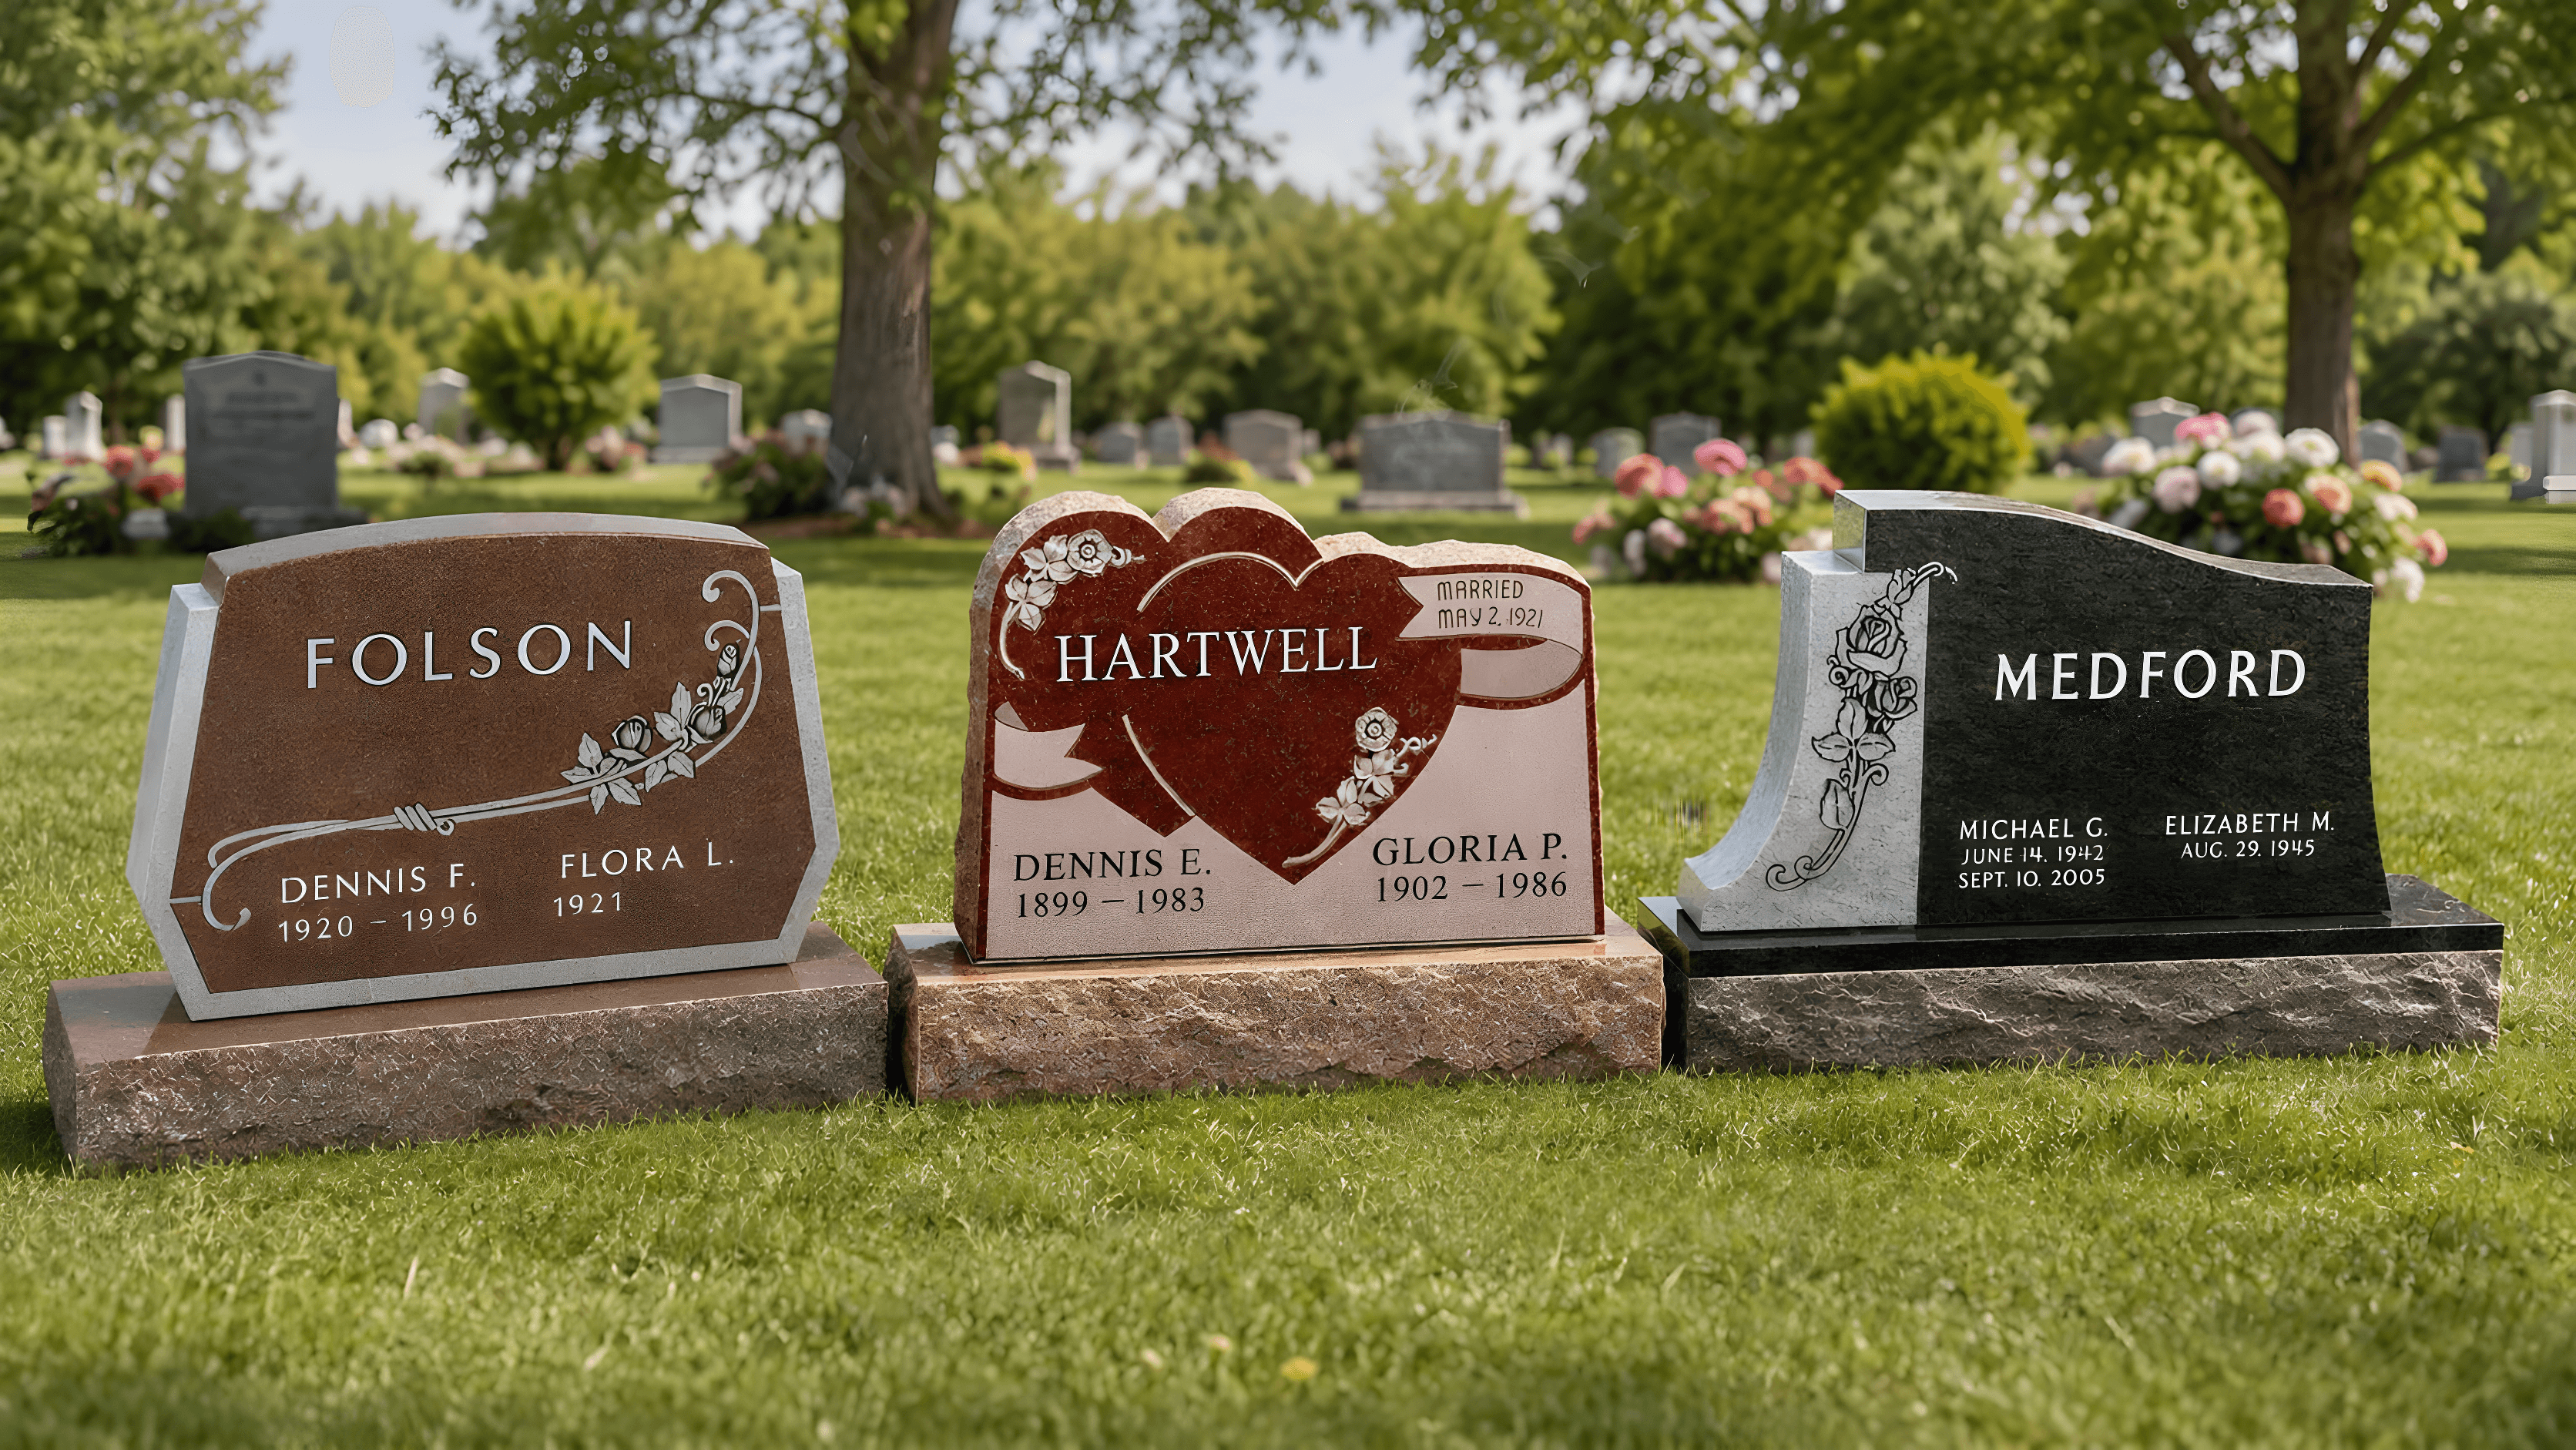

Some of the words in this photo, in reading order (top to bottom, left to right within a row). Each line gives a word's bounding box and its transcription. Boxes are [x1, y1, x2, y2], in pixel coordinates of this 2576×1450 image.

[1437, 579, 1524, 601] MARRIED
[1438, 607, 1482, 629] MAY
[1510, 607, 1543, 629] 1921
[307, 620, 631, 689] FOLSON
[1054, 626, 1377, 682] HARTWELL
[1994, 649, 2306, 701] MEDFORD
[1960, 818, 2074, 840] MICHAEL
[2085, 817, 2108, 837] G.
[2165, 812, 2299, 835] ELIZABETH
[2312, 811, 2334, 831] M.
[562, 844, 685, 879] FLORA
[708, 841, 733, 867] L.
[1013, 848, 1162, 881] DENNIS
[1180, 848, 1211, 875] E.
[1372, 833, 1528, 866] GLORIA
[1541, 833, 1567, 860] P.
[1961, 847, 2013, 865] JUNE
[2023, 846, 2048, 863] 14.
[2058, 844, 2104, 863] 1942
[2180, 841, 2229, 859] AUG.
[2236, 840, 2262, 857] 29.
[2271, 839, 2315, 857] 1945
[281, 866, 426, 904] DENNIS
[450, 863, 475, 888] F.
[1377, 875, 1448, 902] 1902
[1497, 871, 1567, 898] 1986
[1958, 871, 2008, 889] SEPT.
[2017, 871, 2041, 887] 10.
[2051, 868, 2105, 886] 2005
[553, 891, 620, 917] 1921
[1018, 891, 1088, 918] 1899
[1135, 887, 1204, 915] 1983
[278, 915, 353, 942] 1920
[401, 903, 477, 931] 1996
